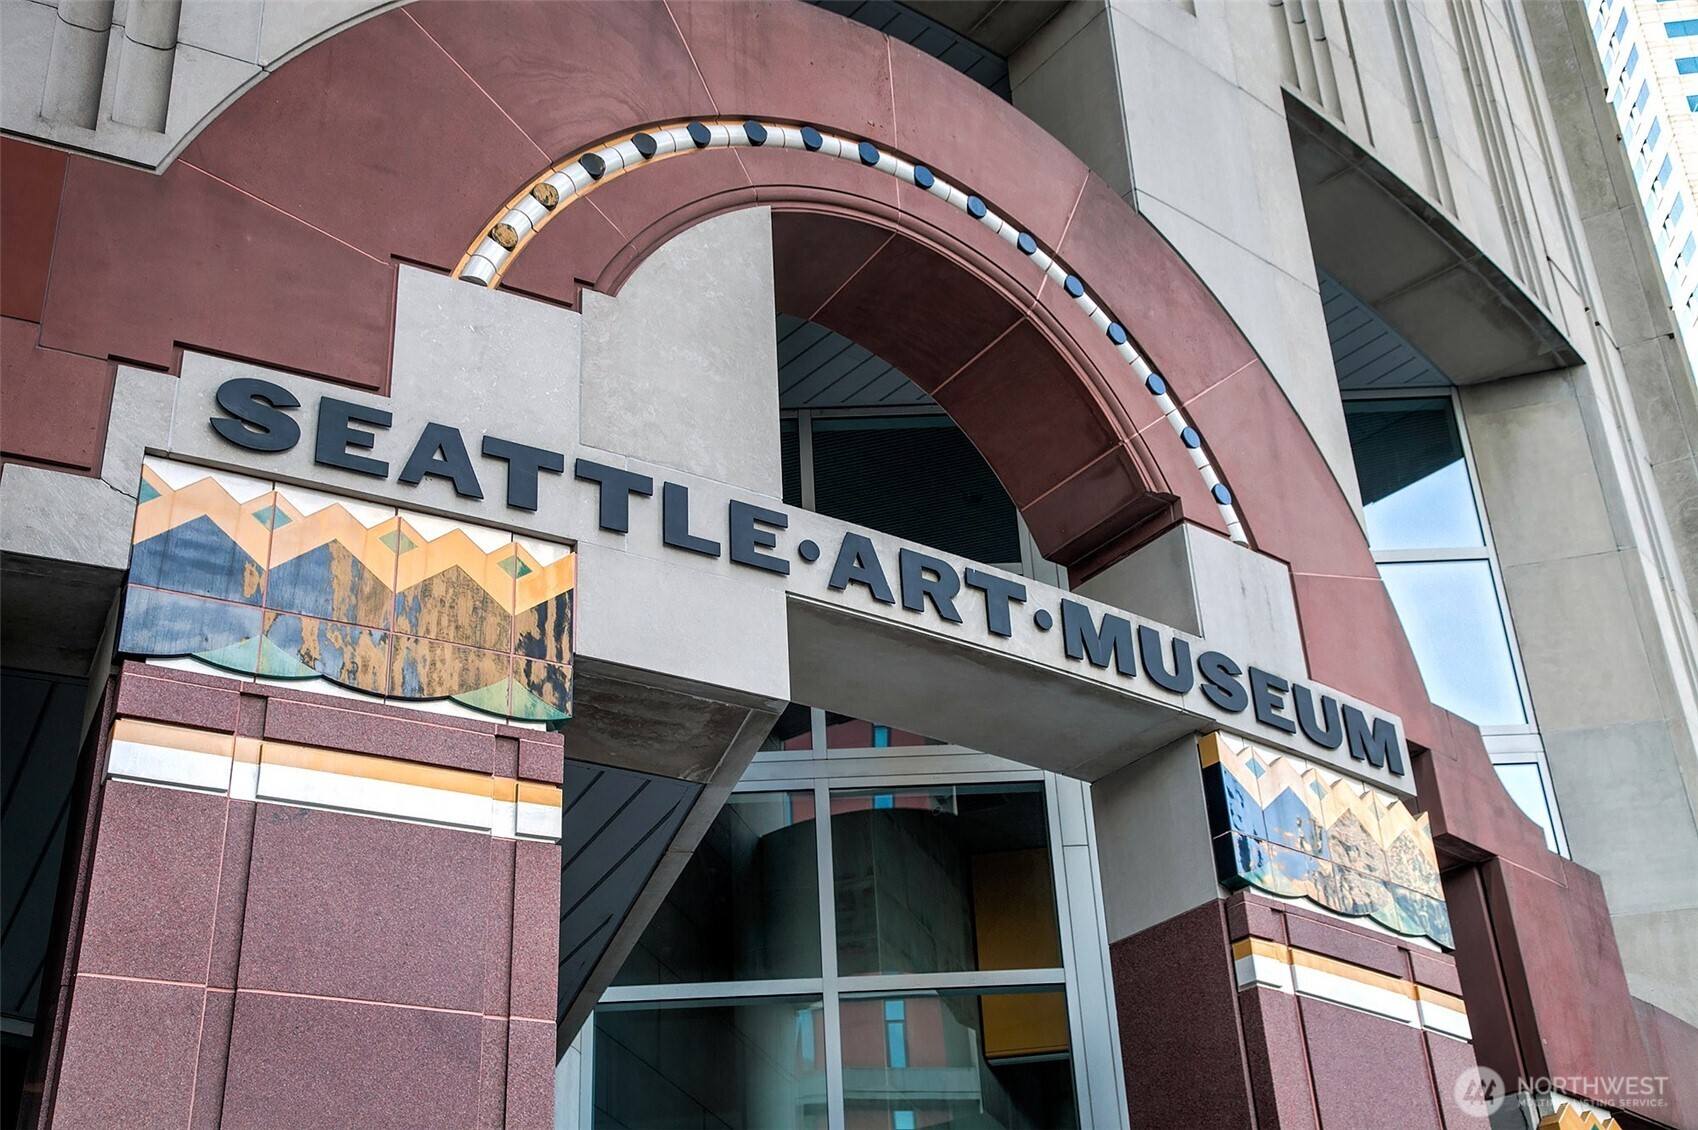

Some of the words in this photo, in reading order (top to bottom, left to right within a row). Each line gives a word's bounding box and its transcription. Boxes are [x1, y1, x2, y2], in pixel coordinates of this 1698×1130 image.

[209, 376, 790, 576] SEATTLE
[828, 531, 1027, 637] ART
[1061, 597, 1405, 776] MUSEUM
